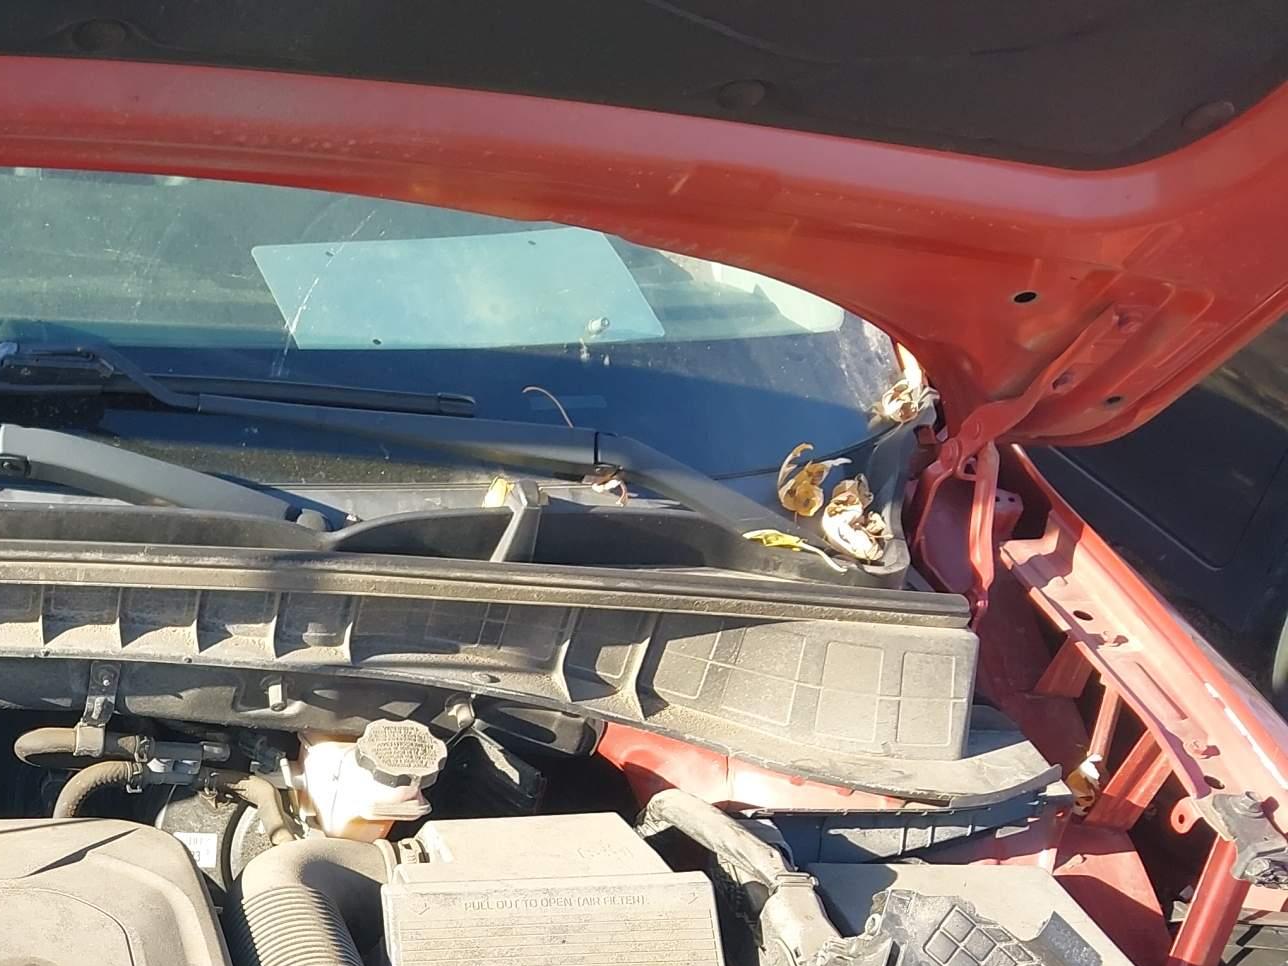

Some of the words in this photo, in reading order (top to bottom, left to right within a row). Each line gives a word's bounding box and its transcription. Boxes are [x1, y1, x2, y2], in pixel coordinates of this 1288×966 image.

[464, 900, 494, 911] PULL
[496, 898, 520, 909] OUT
[522, 897, 538, 908] TO
[540, 896, 573, 908] OPEN
